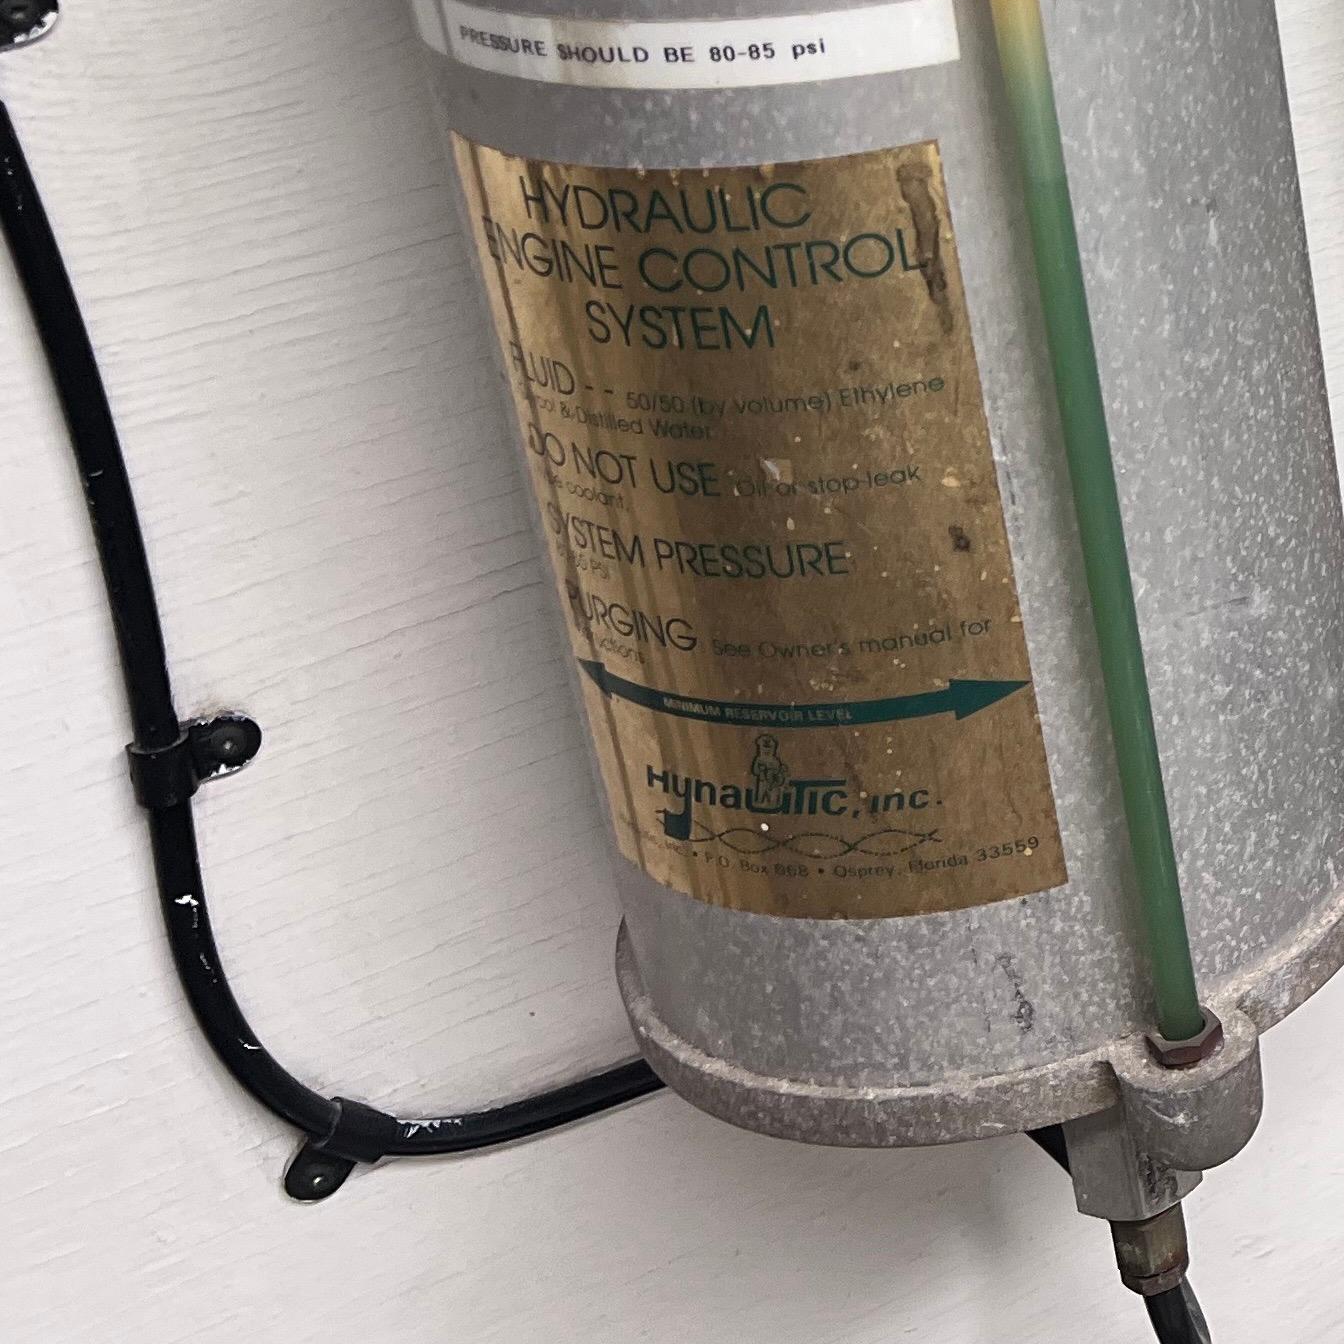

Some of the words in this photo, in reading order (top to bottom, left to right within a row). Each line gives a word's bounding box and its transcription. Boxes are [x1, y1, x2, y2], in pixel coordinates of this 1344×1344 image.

[459, 23, 548, 57] PRESSURE
[556, 42, 650, 64] SHOULD
[664, 45, 697, 64] BE
[708, 41, 777, 64] 80-85
[791, 37, 826, 60] psi
[519, 175, 814, 236] HYDRAULIC
[483, 215, 625, 291] ENGINE
[638, 227, 930, 294] CONTROL
[585, 298, 776, 352] SYSTEM
[577, 406, 643, 436] Distilled
[625, 391, 685, 415] 50/50
[691, 393, 726, 419] (by
[735, 392, 832, 416] volume)
[839, 375, 945, 409] Ethylene
[528, 421, 567, 468] DO
[571, 441, 637, 489] NOT
[650, 458, 721, 498] USE
[775, 479, 800, 497] or
[806, 463, 920, 496] stop-leak
[546, 501, 646, 569] SYSTEM
[652, 537, 850, 580] PRESSURE
[564, 576, 698, 652] PURGING
[711, 637, 752, 657] See
[858, 625, 950, 654] manual
[959, 617, 993, 637] for
[662, 696, 722, 718] MINIMUM
[724, 705, 804, 723] RESERVOIR
[807, 706, 855, 722] LEVEL
[974, 835, 1041, 863] 33559
